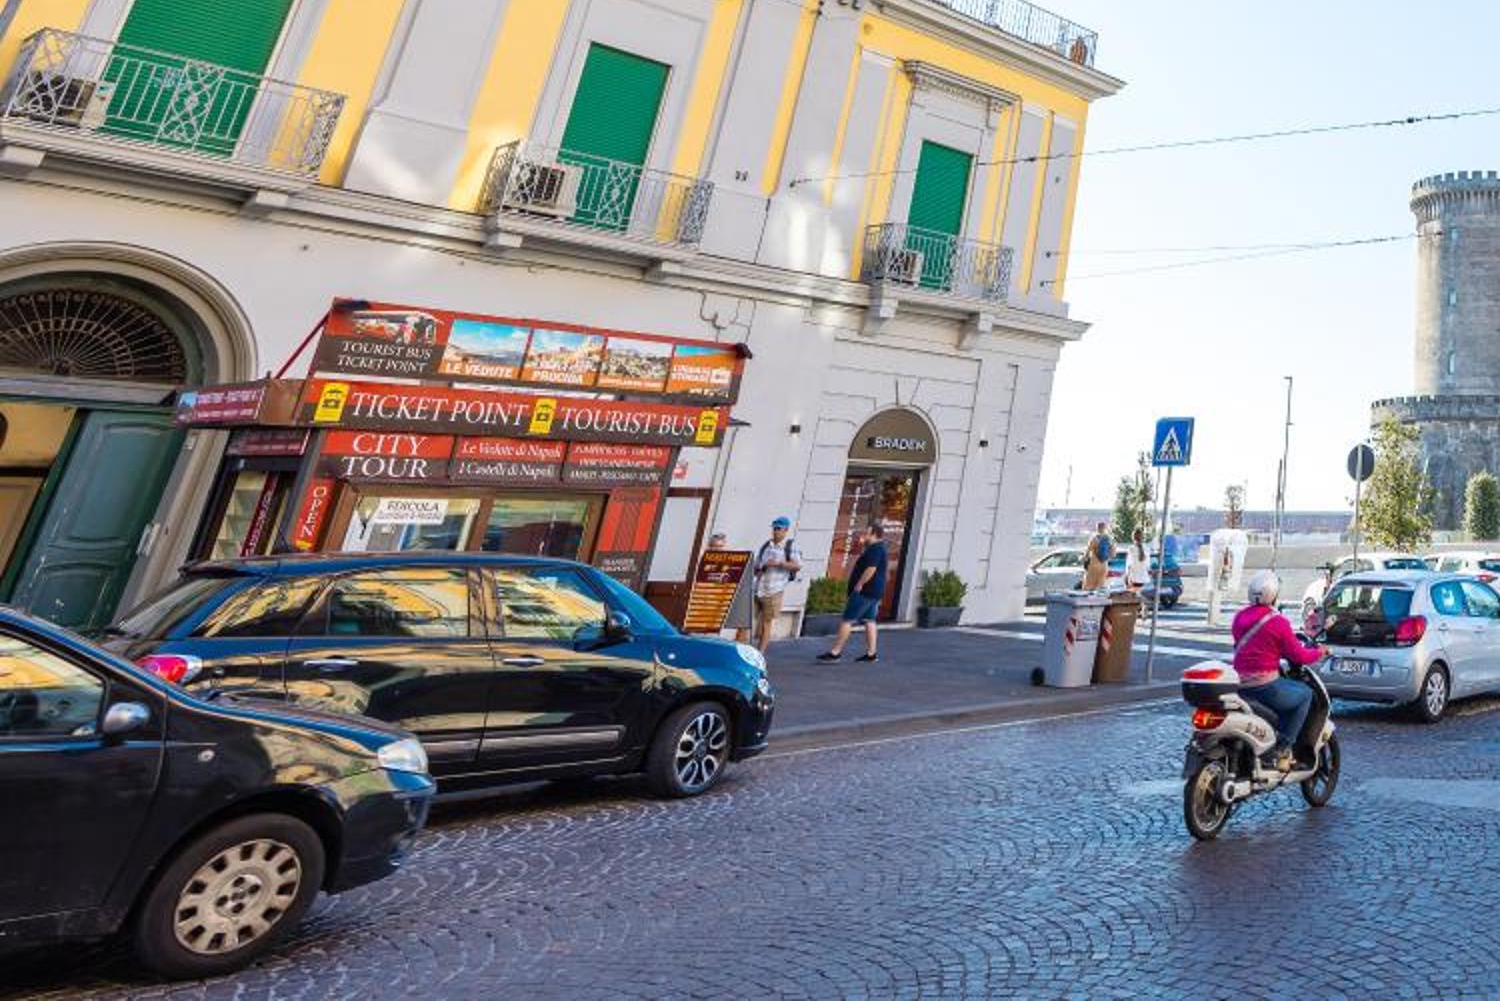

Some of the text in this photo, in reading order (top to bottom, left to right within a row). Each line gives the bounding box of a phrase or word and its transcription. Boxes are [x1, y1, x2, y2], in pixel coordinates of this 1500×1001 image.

[342, 341, 432, 359] TOURIST BUS
[337, 355, 426, 373] TICKET POINT
[445, 362, 513, 378] LE VEDUTE
[351, 392, 530, 426] TICKET POINT
[560, 407, 696, 436] TOURIST BUS
[352, 433, 429, 456] CITY
[341, 456, 429, 478] TOUR
[300, 486, 328, 538] OPEN
